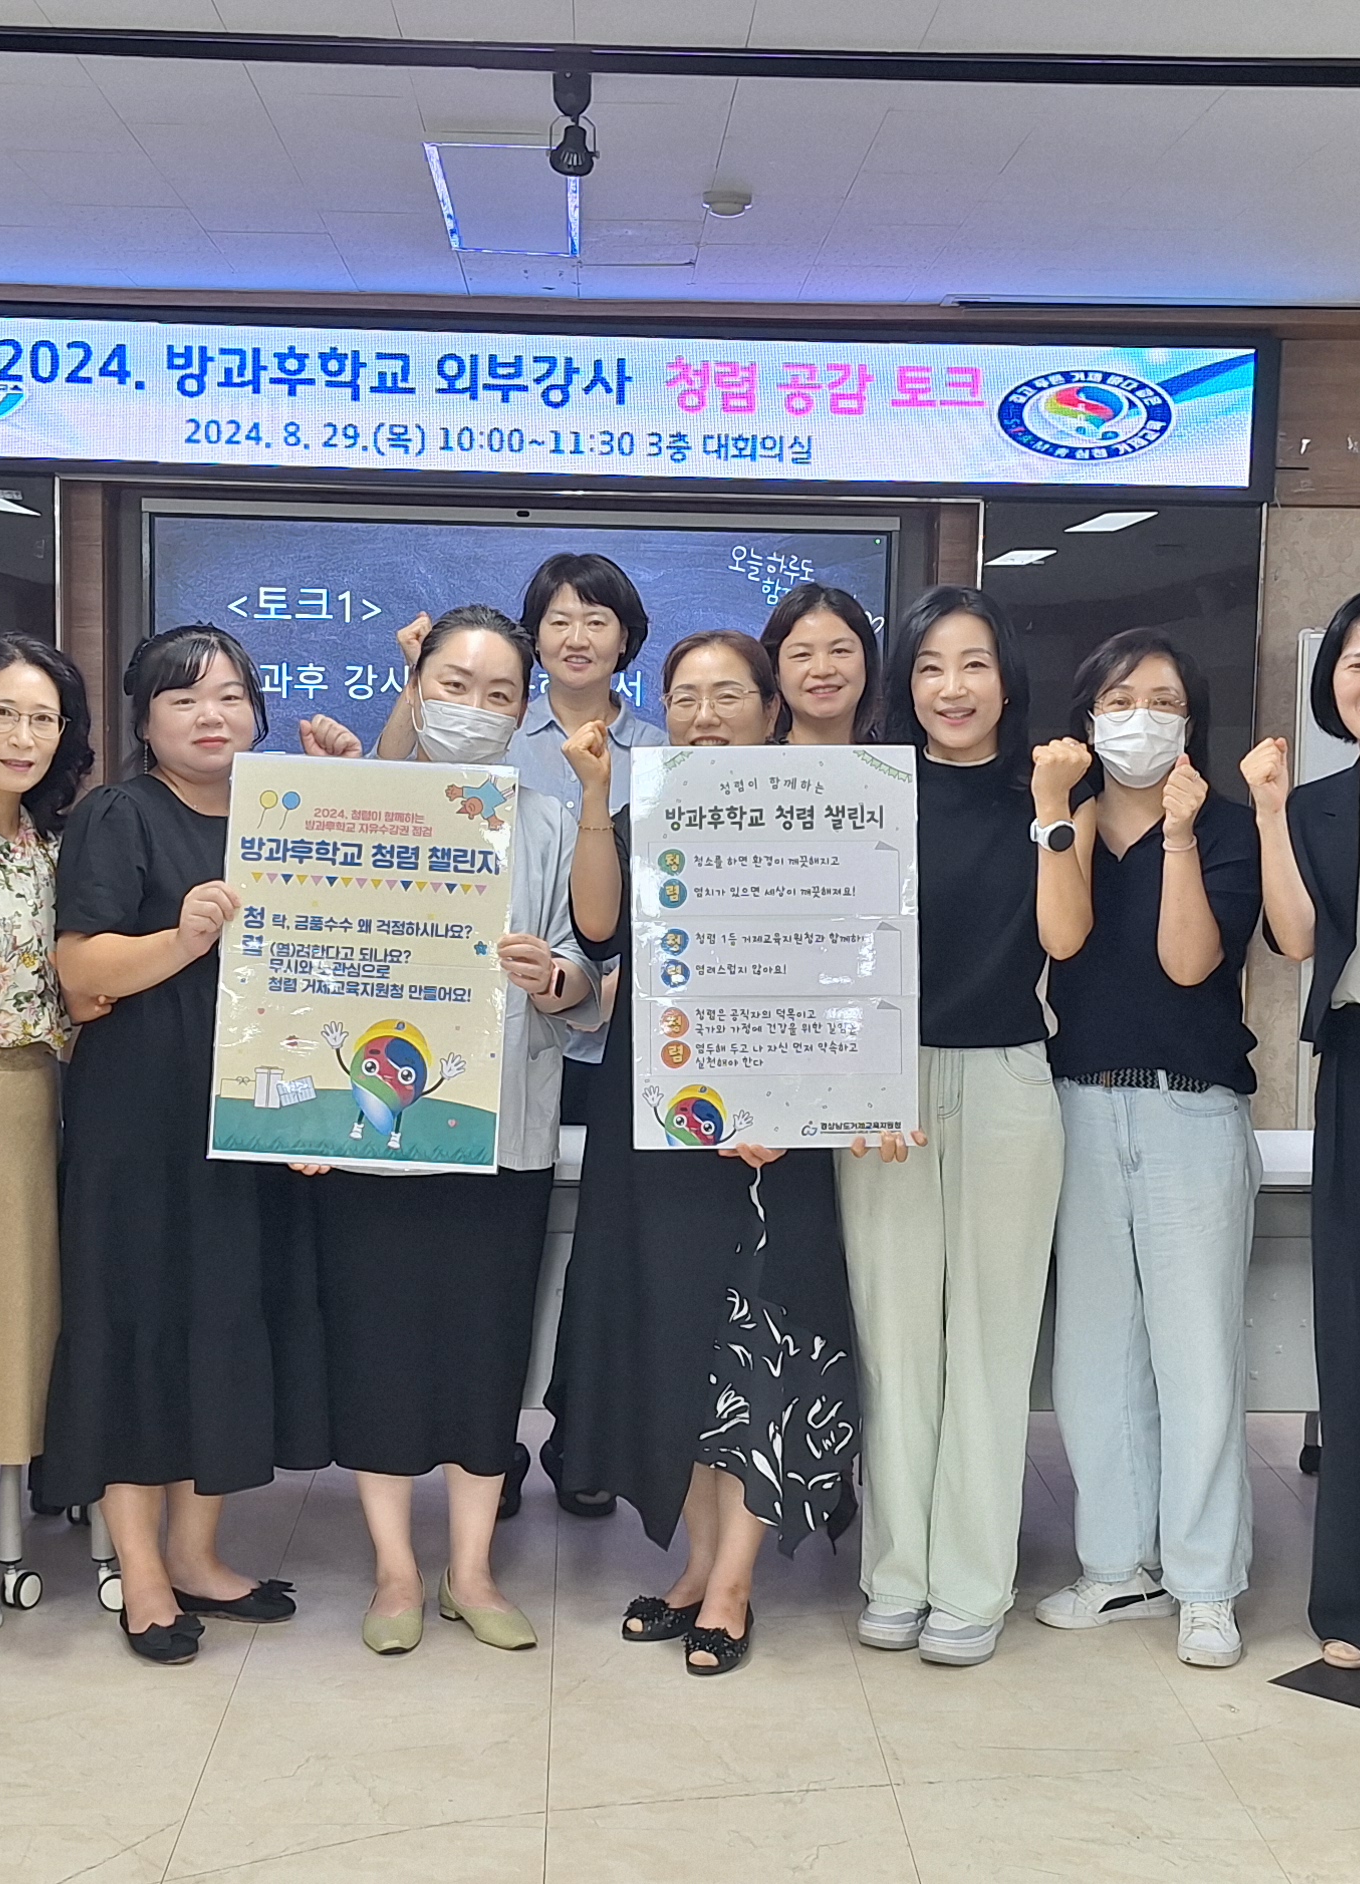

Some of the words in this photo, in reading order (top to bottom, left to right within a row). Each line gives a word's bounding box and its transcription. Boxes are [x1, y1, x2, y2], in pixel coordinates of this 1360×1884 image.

[166, 344, 416, 402] 방과후학교
[436, 351, 633, 408] 외부강사
[666, 356, 758, 414] 청렴
[776, 361, 874, 417] 공감
[891, 364, 985, 408] 토크
[184, 418, 272, 448] 2024.
[283, 421, 310, 450] 8.
[322, 422, 427, 456] 29.(목)
[439, 426, 635, 456] 10:00~11:30
[646, 431, 692, 463] 3층
[702, 432, 812, 465] 대회의실
[728, 546, 763, 581] 오늘
[766, 552, 815, 584] 하루도
[761, 577, 791, 605] 함
[227, 587, 382, 623] <토크1>
[259, 662, 329, 700] 과후
[720, 777, 758, 795] 청렴이
[769, 776, 824, 795] 함께하는
[314, 808, 348, 820] 2024.
[351, 809, 382, 822] 청렴이
[384, 811, 425, 824] 함께하는
[666, 804, 766, 831] 방과후학교
[775, 804, 815, 831] 청렴
[824, 803, 885, 831] 챌린지
[305, 820, 356, 833] 방과후학교
[358, 822, 409, 836] 자유수강권
[240, 836, 363, 867] 방과후학교
[371, 843, 420, 871] 청렴
[428, 845, 500, 875] 챌린지
[694, 855, 723, 869] 청소를
[727, 855, 748, 867] 하면
[752, 854, 784, 868] 환경이
[788, 855, 840, 868] 깨끗해지고
[694, 886, 726, 898] 염치가
[730, 886, 760, 898] 있으면
[764, 885, 796, 898] 세상이
[244, 906, 265, 929] 청
[294, 915, 353, 933] 금품수수
[357, 918, 372, 934] 왜
[376, 919, 473, 940] 걱정하시나요?
[242, 935, 263, 957] 렴
[359, 948, 411, 963] 되나요?
[695, 932, 715, 945] 청렴
[721, 932, 738, 946] 1등
[742, 932, 825, 946] 거제교육지원청과
[829, 932, 868, 945] 함께하
[695, 963, 747, 976] 염려스럽지
[752, 963, 786, 976] 않아요!
[268, 977, 297, 993] 청렴
[301, 978, 404, 999] 거제교육지원청
[409, 984, 471, 1003] 만들어요!
[695, 1008, 726, 1021] 청렴은
[730, 1008, 771, 1021] 공직자의
[776, 1008, 816, 1021] 덕목이고
[695, 1023, 725, 1036] 국가와
[730, 1022, 762, 1035] 가정에
[766, 1022, 797, 1036] 건강을
[801, 1022, 822, 1034] 위한
[695, 1043, 726, 1055] 염두해
[730, 1043, 749, 1055] 두고
[752, 1045, 763, 1053] 나
[767, 1042, 788, 1054] 자신
[793, 1042, 813, 1054] 먼저
[818, 1041, 858, 1055] 약속하고
[695, 1056, 738, 1070] 실천해야
[742, 1055, 764, 1068] 한다
